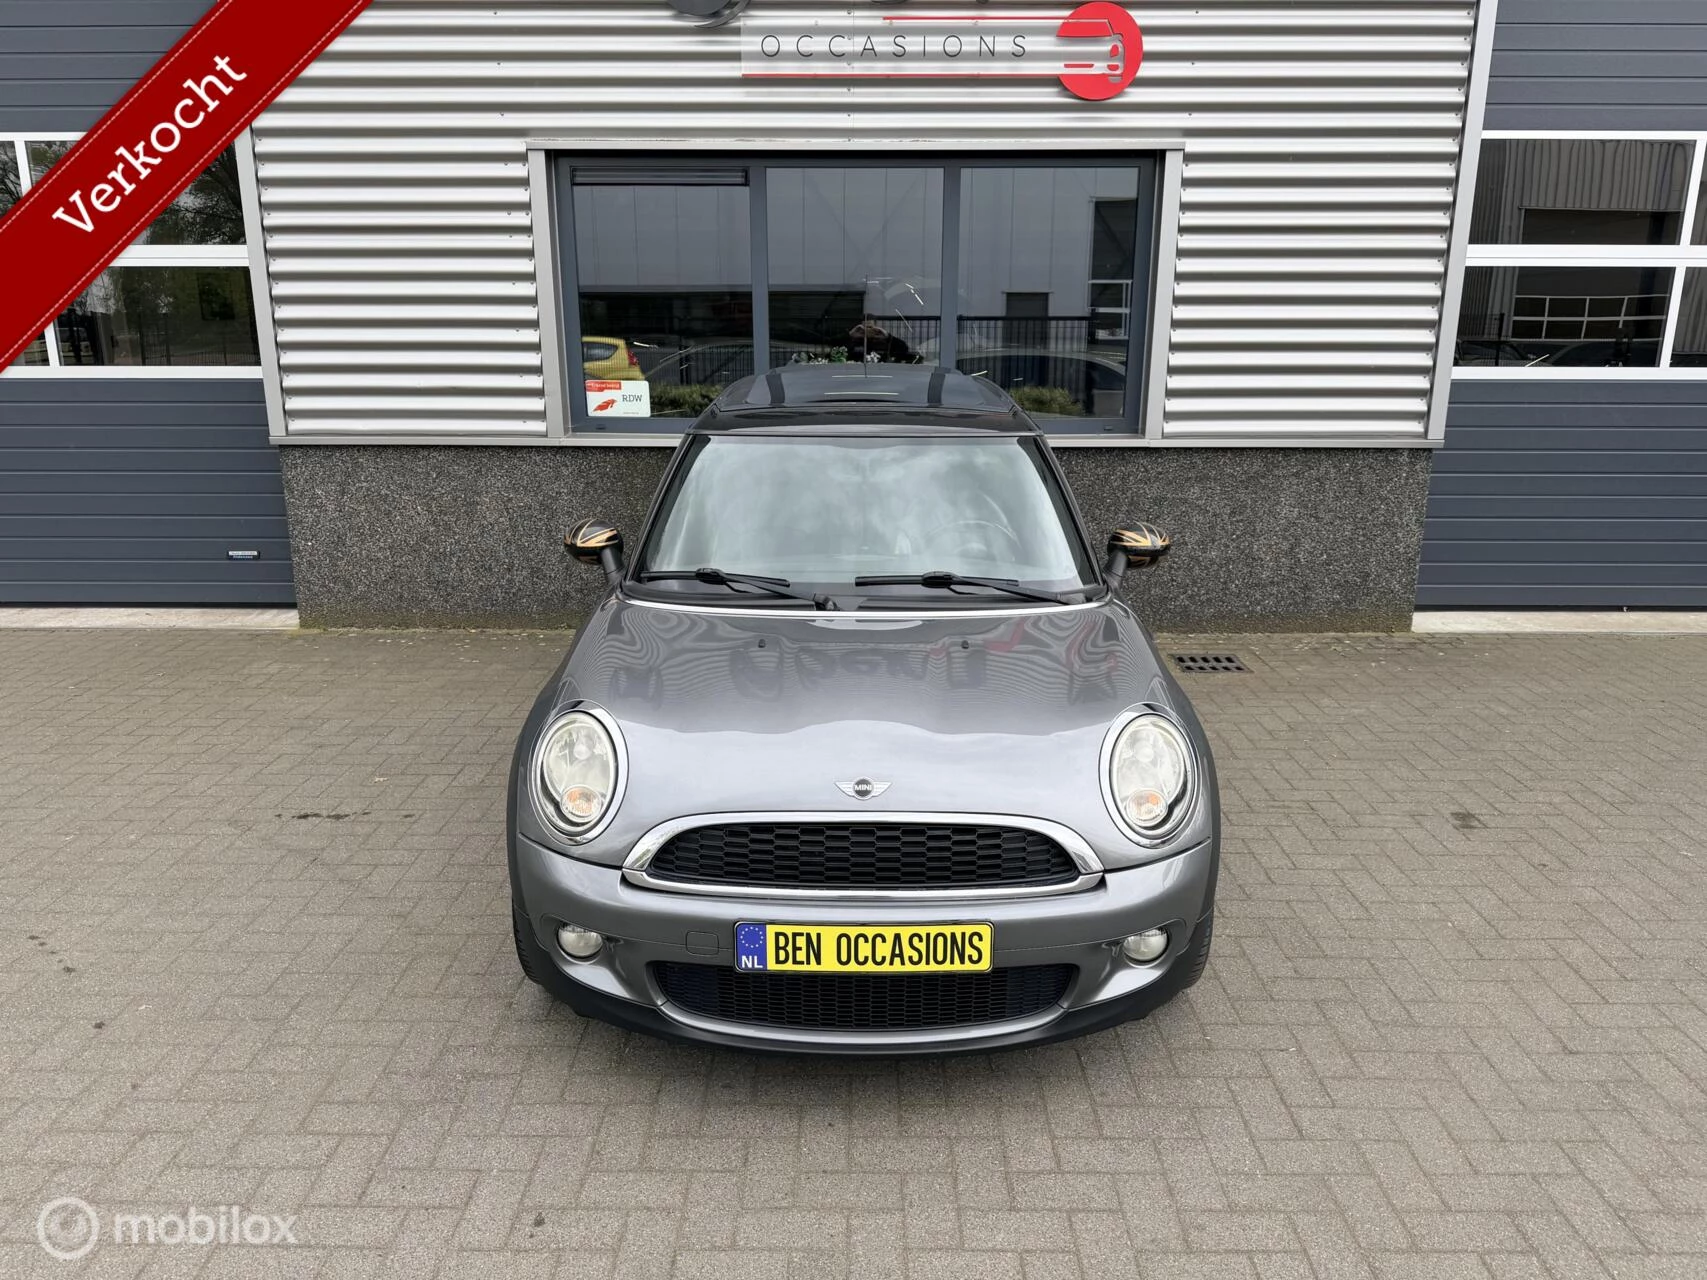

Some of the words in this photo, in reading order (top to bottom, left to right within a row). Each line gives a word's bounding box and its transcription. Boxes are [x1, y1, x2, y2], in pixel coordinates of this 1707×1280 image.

[760, 34, 1027, 58] OCCASIONS
[622, 394, 643, 403] RDW
[854, 783, 873, 792] MINI
[774, 931, 822, 966] BEN
[836, 931, 984, 967] OCCASIONS
[741, 955, 763, 969] NL
